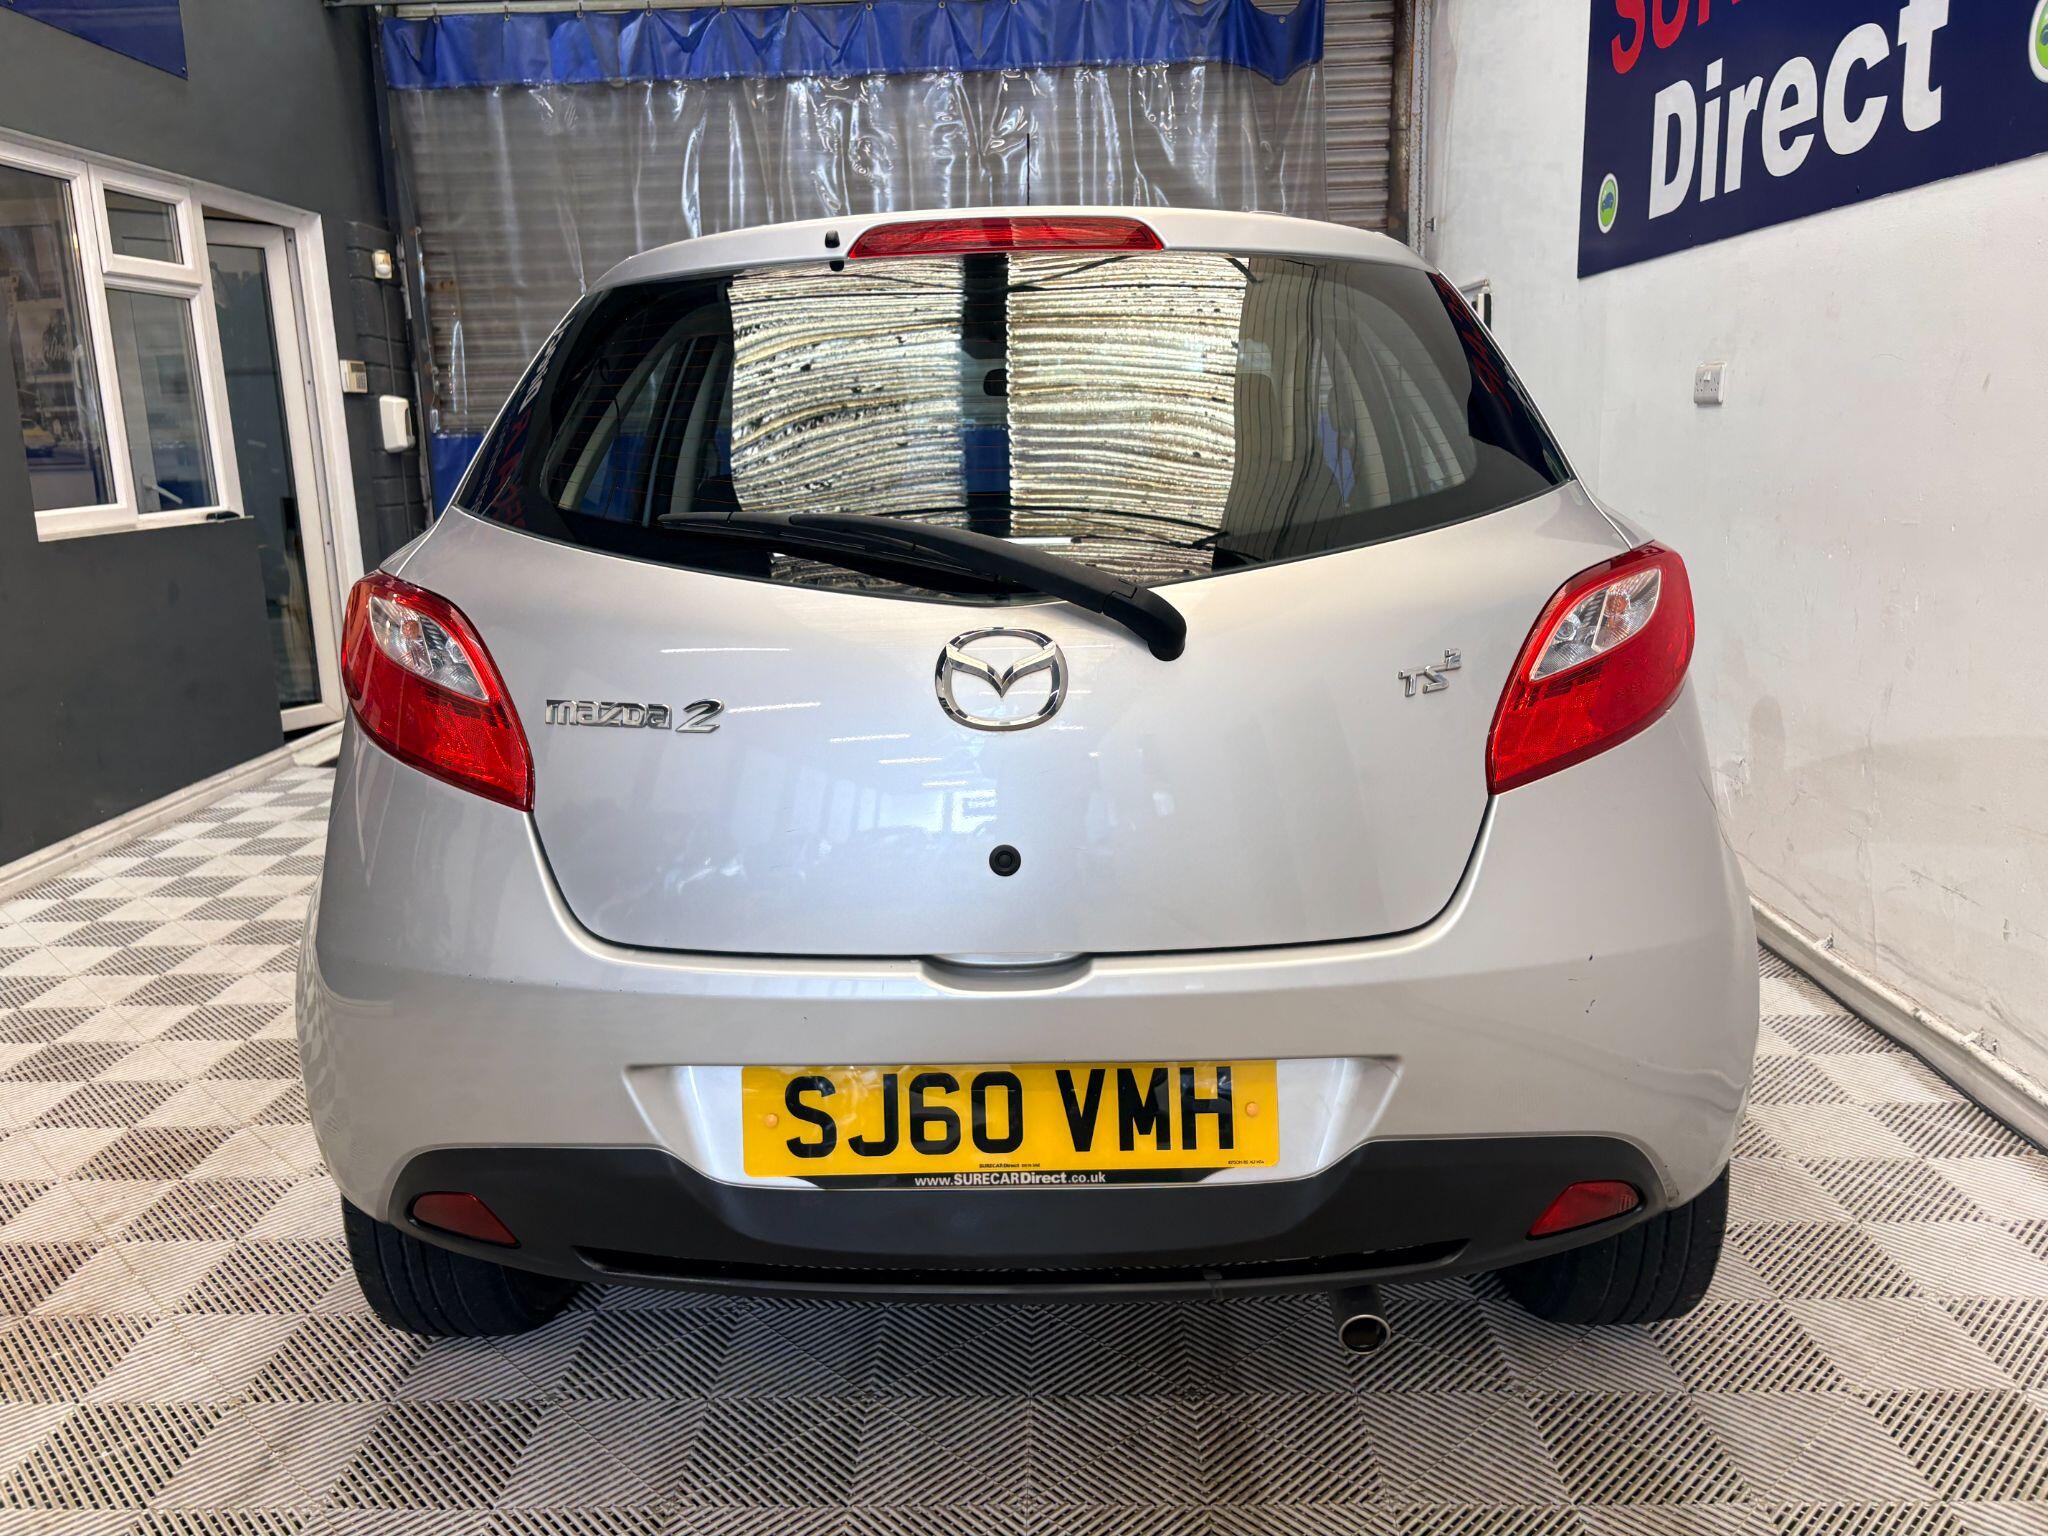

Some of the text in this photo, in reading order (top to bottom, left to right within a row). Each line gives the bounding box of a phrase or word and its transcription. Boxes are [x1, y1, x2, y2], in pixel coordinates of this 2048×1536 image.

[1648, 0, 1950, 221] Direct
[675, 698, 725, 734] 2
[785, 1065, 1235, 1159] SJ60 VMH
[914, 1171, 1106, 1187] www.SURECARDirect.co.uk
